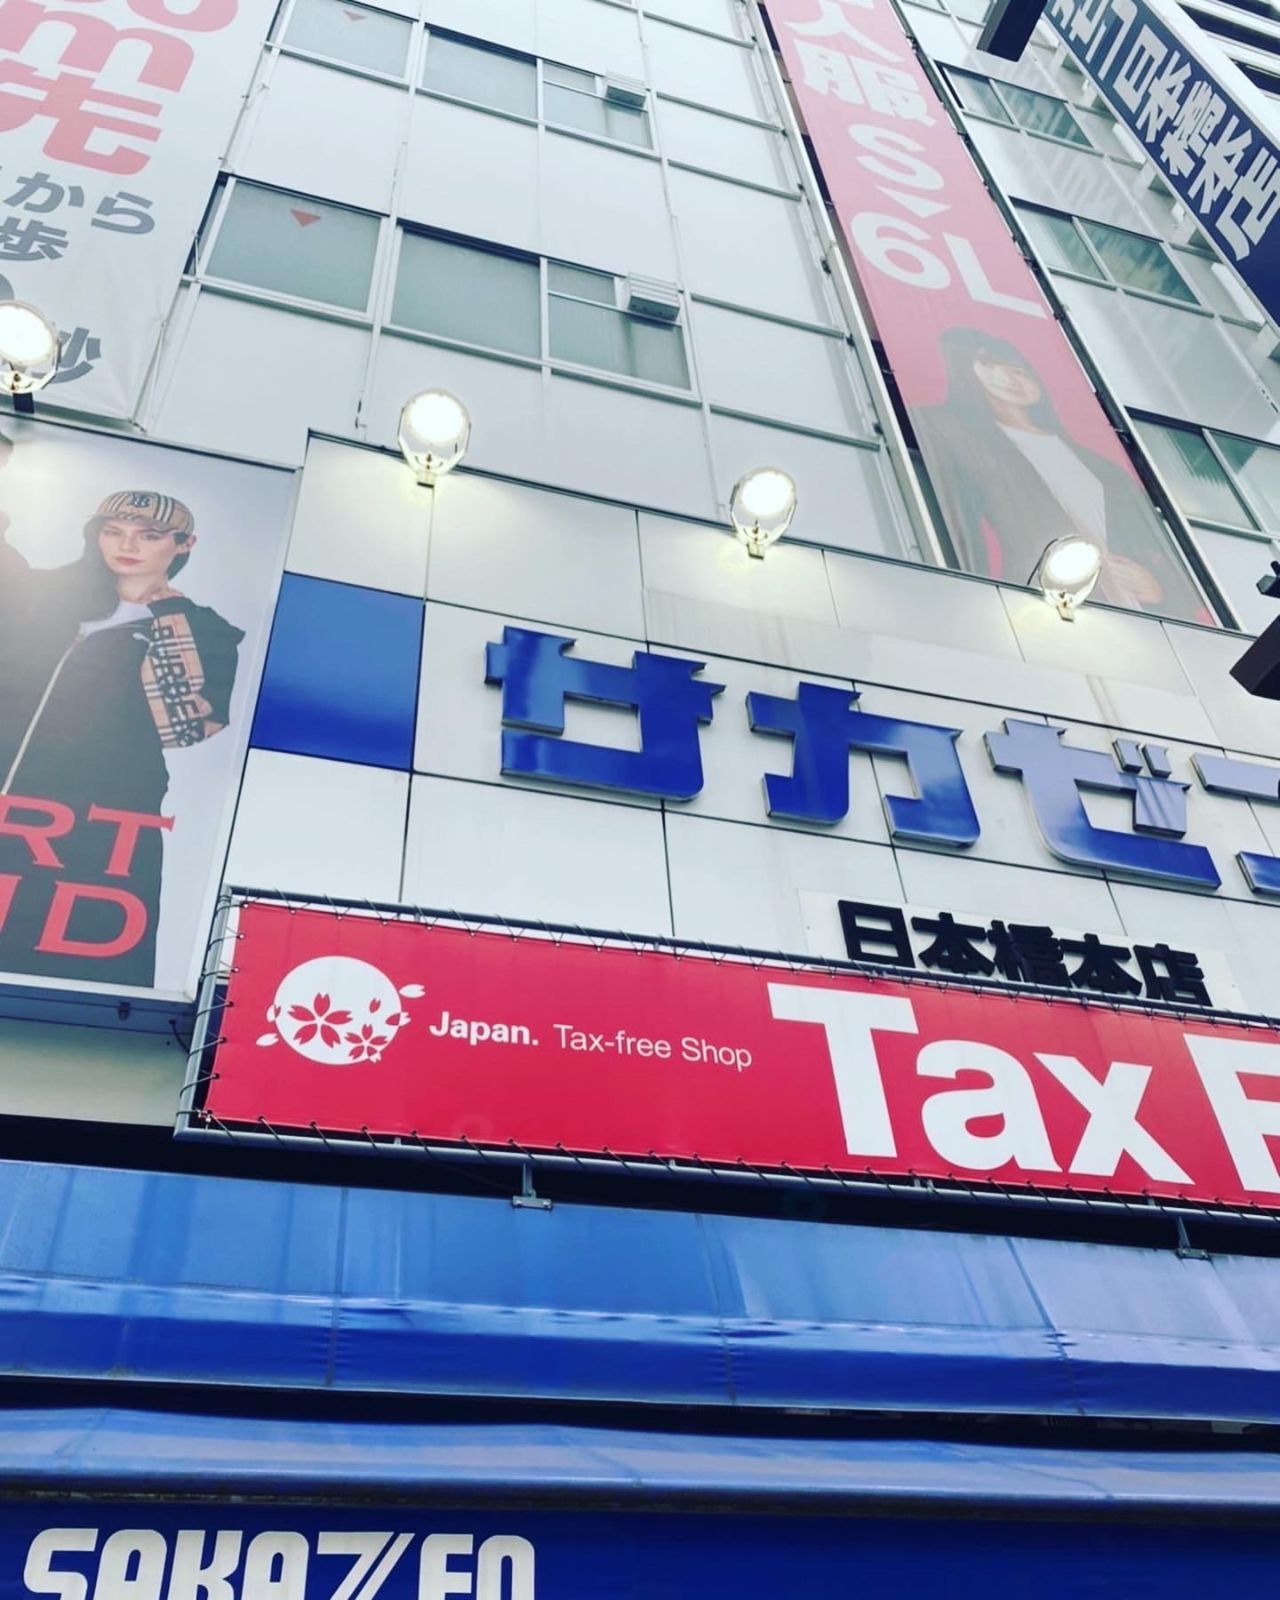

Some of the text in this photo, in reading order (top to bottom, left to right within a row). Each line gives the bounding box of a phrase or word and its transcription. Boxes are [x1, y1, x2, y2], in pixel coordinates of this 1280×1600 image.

[837, 899, 1213, 1008] 日本橋本店
[429, 1011, 753, 1072] Japan. Tax-free Shop
[766, 982, 1196, 1186] Tax
